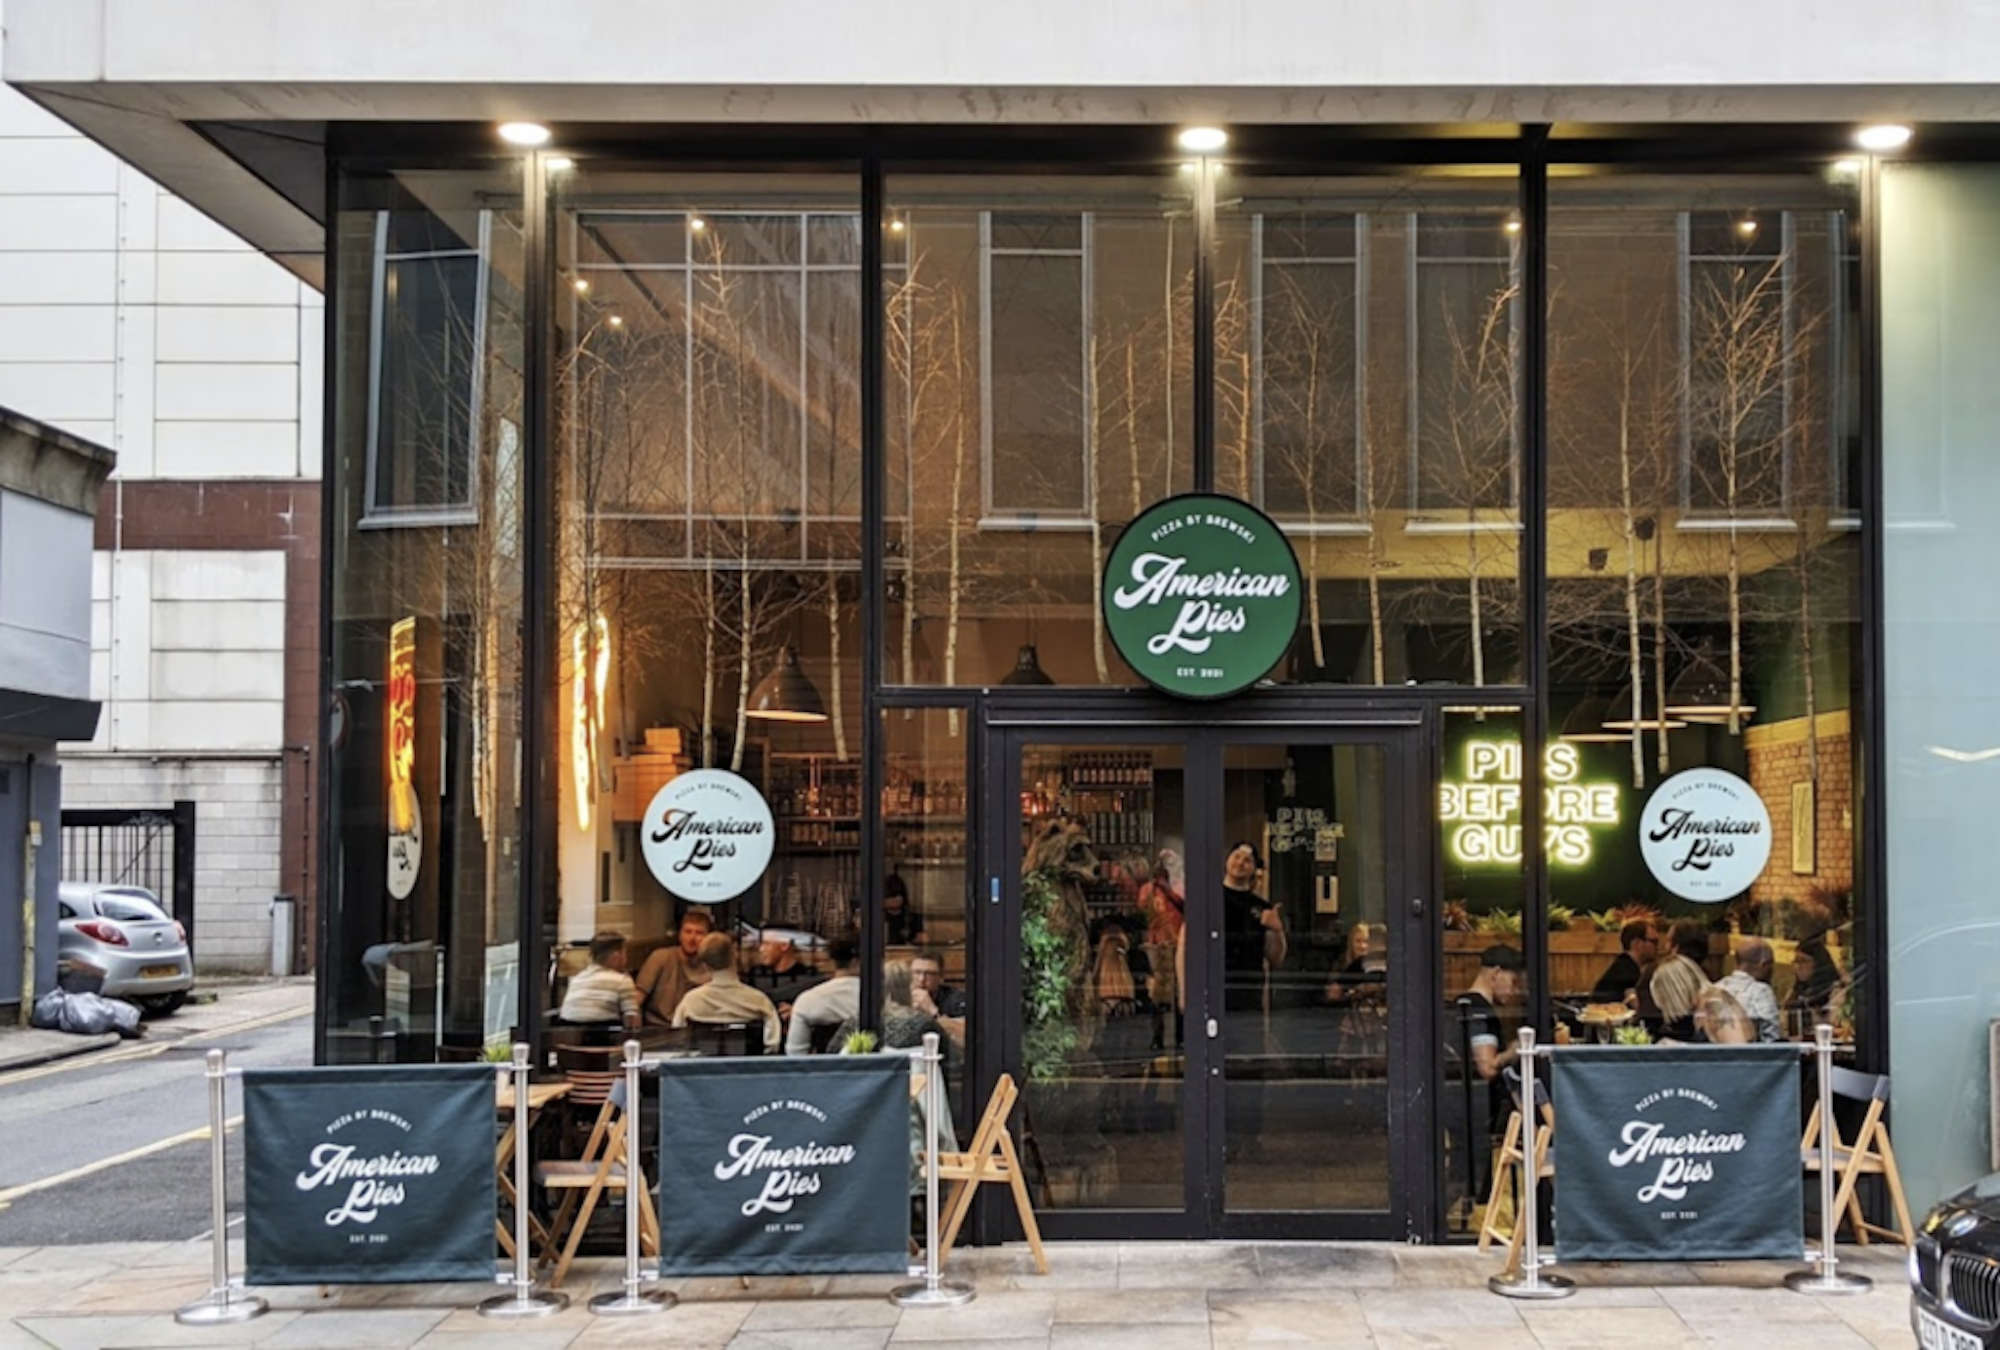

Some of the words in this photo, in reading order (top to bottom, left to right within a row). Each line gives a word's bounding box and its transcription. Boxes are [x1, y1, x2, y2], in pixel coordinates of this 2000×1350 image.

[1151, 519, 1183, 542] PIZZA
[1186, 514, 1202, 525] BY
[1206, 514, 1256, 544] BREWSKI
[1114, 552, 1290, 609] American
[1147, 600, 1246, 654] Pies
[1466, 741, 1579, 781] PIS
[1439, 783, 1620, 823] BEFRE
[650, 808, 764, 843] American
[1649, 807, 1761, 842] American
[672, 838, 736, 873] Pies
[1671, 837, 1734, 872] Pies
[743, 1105, 769, 1125] PIZZA
[771, 1100, 784, 1110] BY
[786, 1100, 828, 1123] BREWSKI
[1634, 1092, 1660, 1112] PIZZA
[1662, 1088, 1675, 1098] BY
[1678, 1088, 1719, 1110] BREWSKI
[326, 1114, 352, 1135] PIZZA
[355, 1109, 368, 1119] BY
[370, 1109, 412, 1132] BREWSKI
[714, 1133, 856, 1180] American
[1608, 1120, 1746, 1167] American
[296, 1143, 440, 1191] American
[1637, 1157, 1714, 1203] Pies
[325, 1179, 405, 1226] Pies
[741, 1170, 821, 1217] Pies
